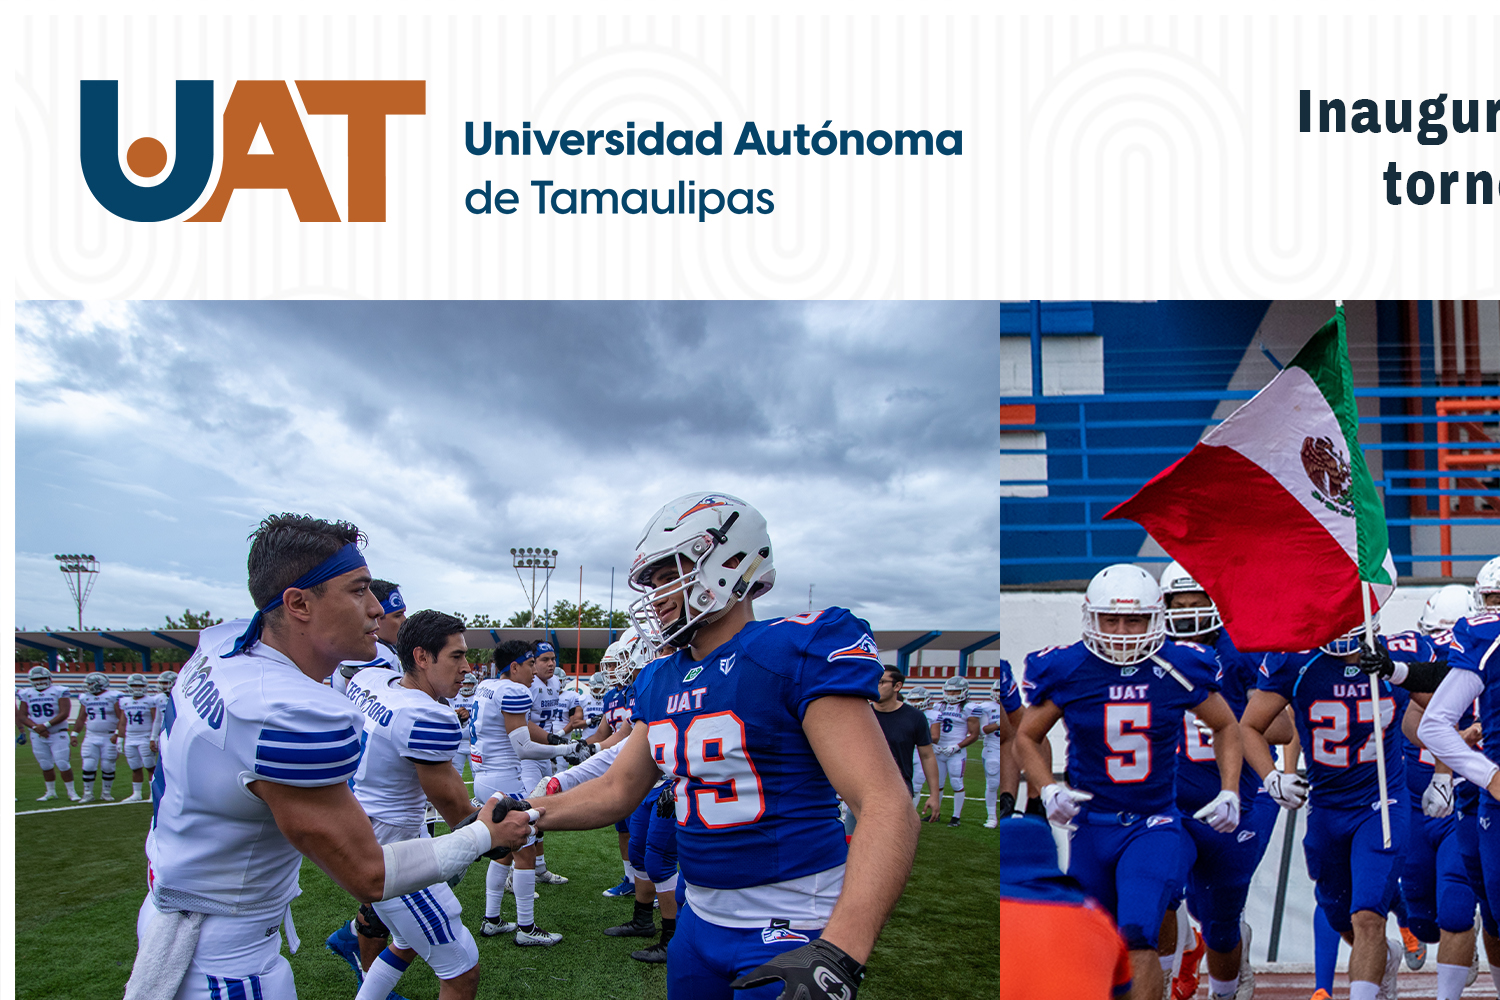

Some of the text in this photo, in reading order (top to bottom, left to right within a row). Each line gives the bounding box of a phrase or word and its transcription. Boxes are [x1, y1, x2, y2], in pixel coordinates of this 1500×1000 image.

[1108, 684, 1148, 700] UAT
[1333, 683, 1370, 698] UAT
[666, 687, 707, 714] UAT
[31, 703, 54, 718] 96
[86, 708, 106, 720] 51
[127, 711, 144, 725] 14
[1308, 697, 1397, 768] 27
[1104, 702, 1151, 783] 5
